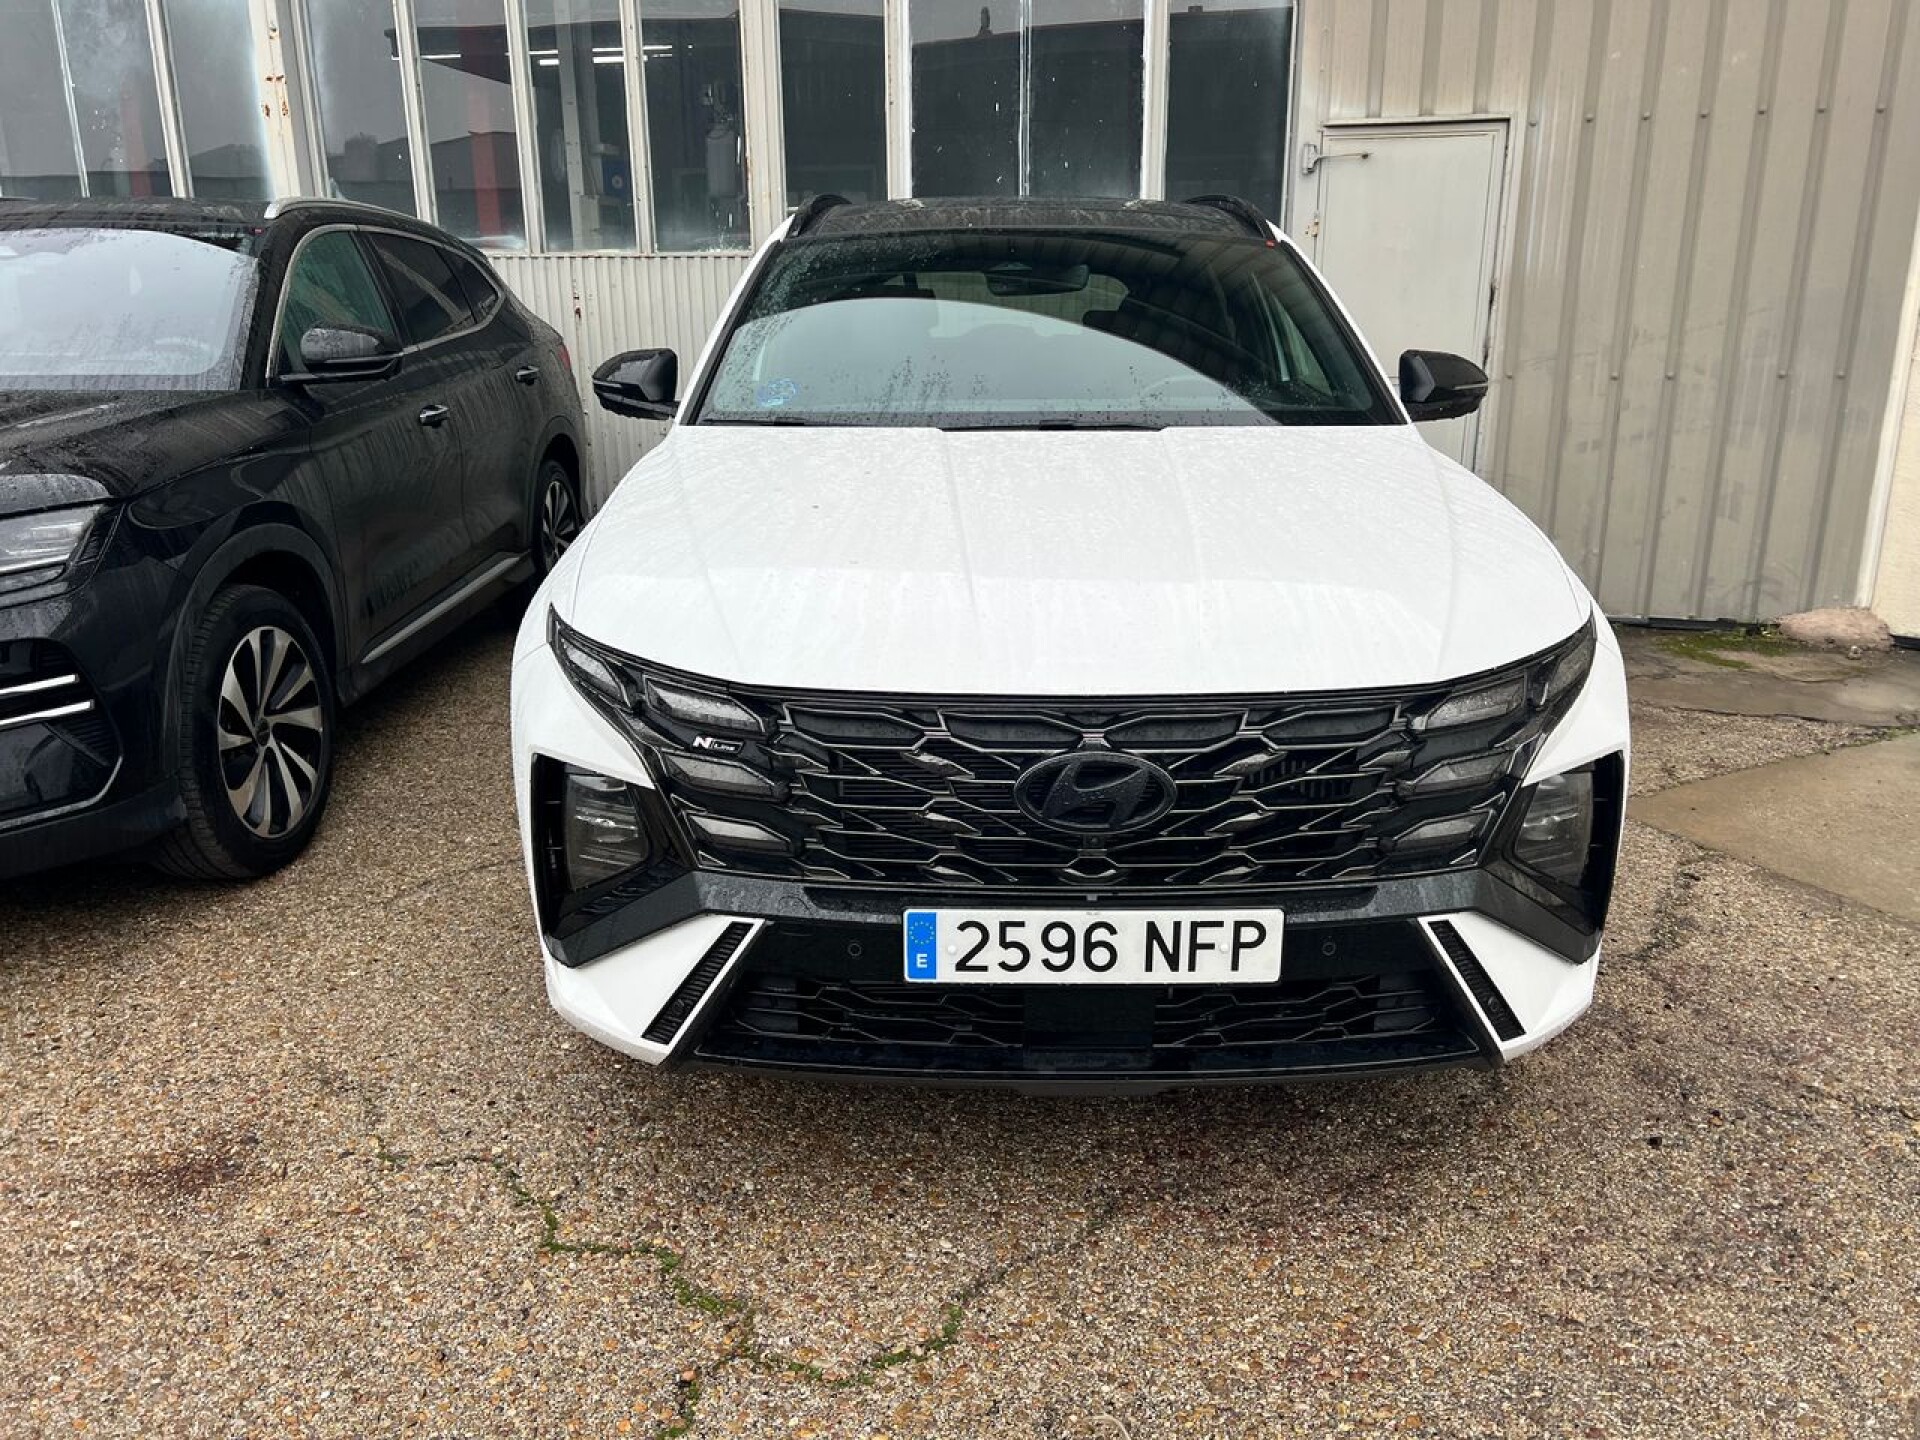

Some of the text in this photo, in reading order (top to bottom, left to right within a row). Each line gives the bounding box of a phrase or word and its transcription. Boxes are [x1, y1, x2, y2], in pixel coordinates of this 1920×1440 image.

[693, 736, 712, 749] N
[956, 921, 1267, 973] 2596 NFP
[916, 953, 928, 968] E
